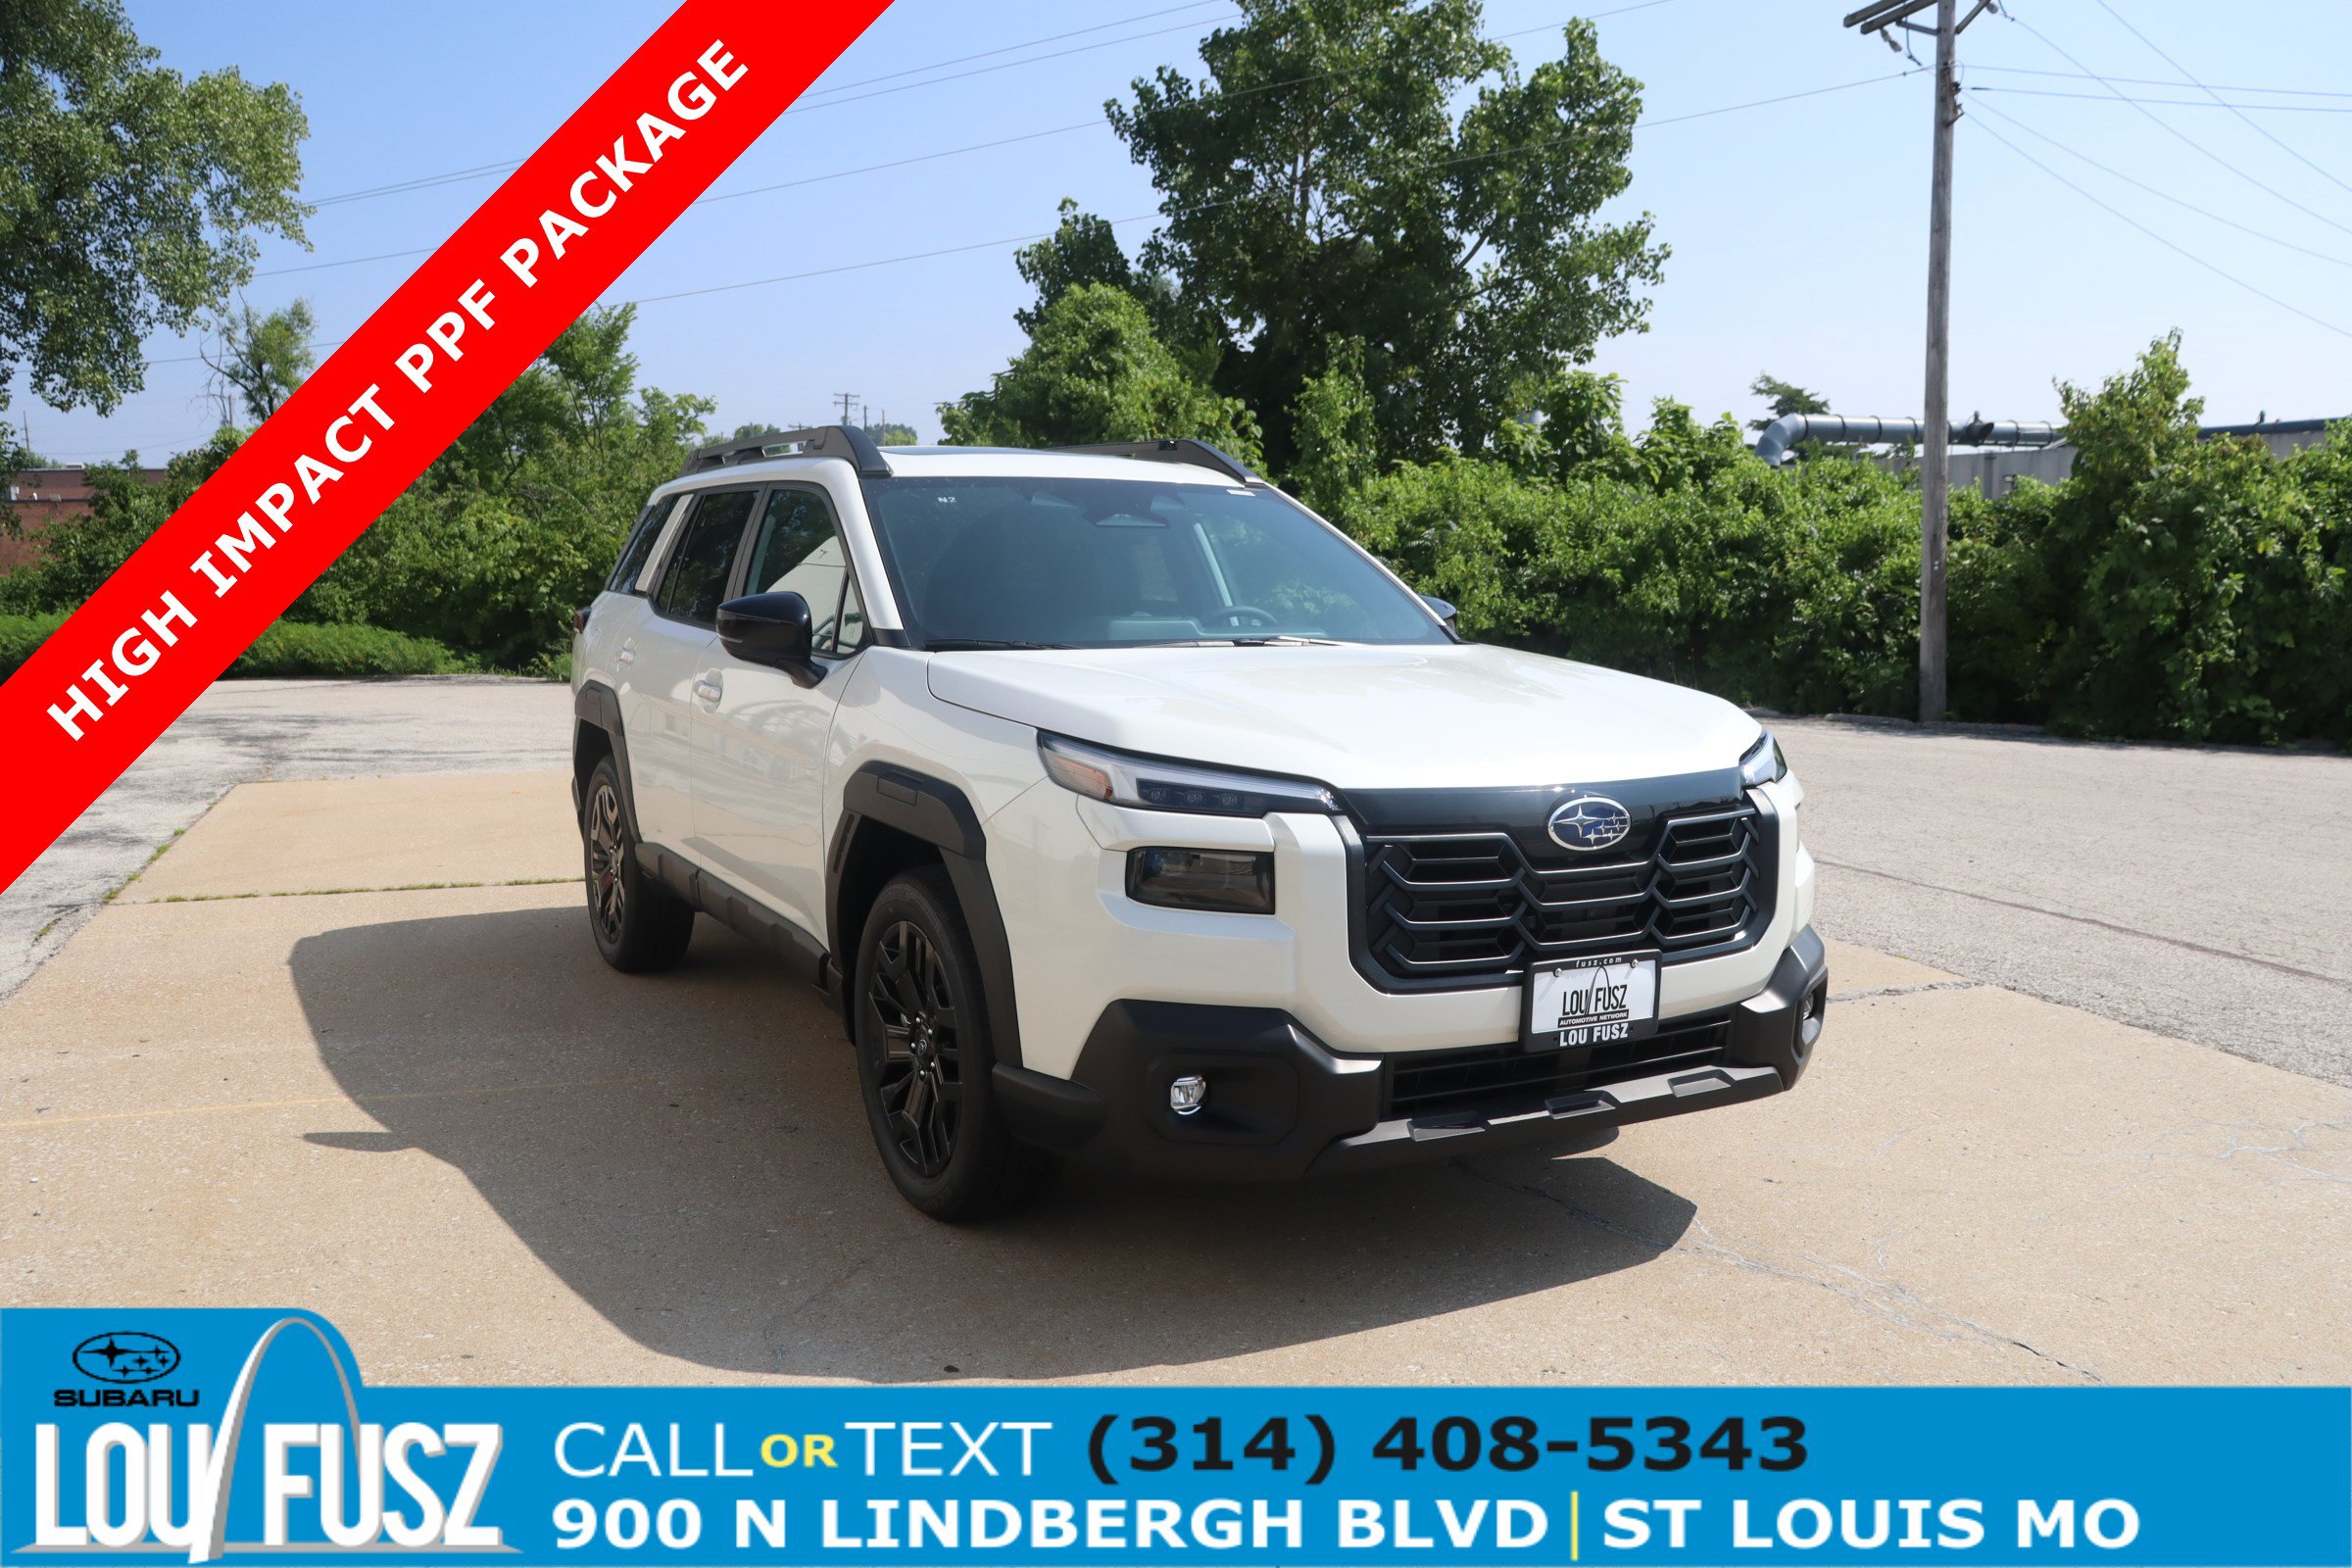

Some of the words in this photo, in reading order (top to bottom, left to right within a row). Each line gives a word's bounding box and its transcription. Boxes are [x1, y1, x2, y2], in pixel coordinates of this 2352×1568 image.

[1575, 956, 1622, 967] fusz.com
[1562, 989, 1589, 1016] LOU
[1594, 984, 1628, 1012] FUSZ
[1559, 1016, 1598, 1026] AUTOMOTIVE
[1599, 1011, 1628, 1021] NETWORK
[1560, 1029, 1588, 1047] LOU
[1592, 1022, 1629, 1043] FUSZ
